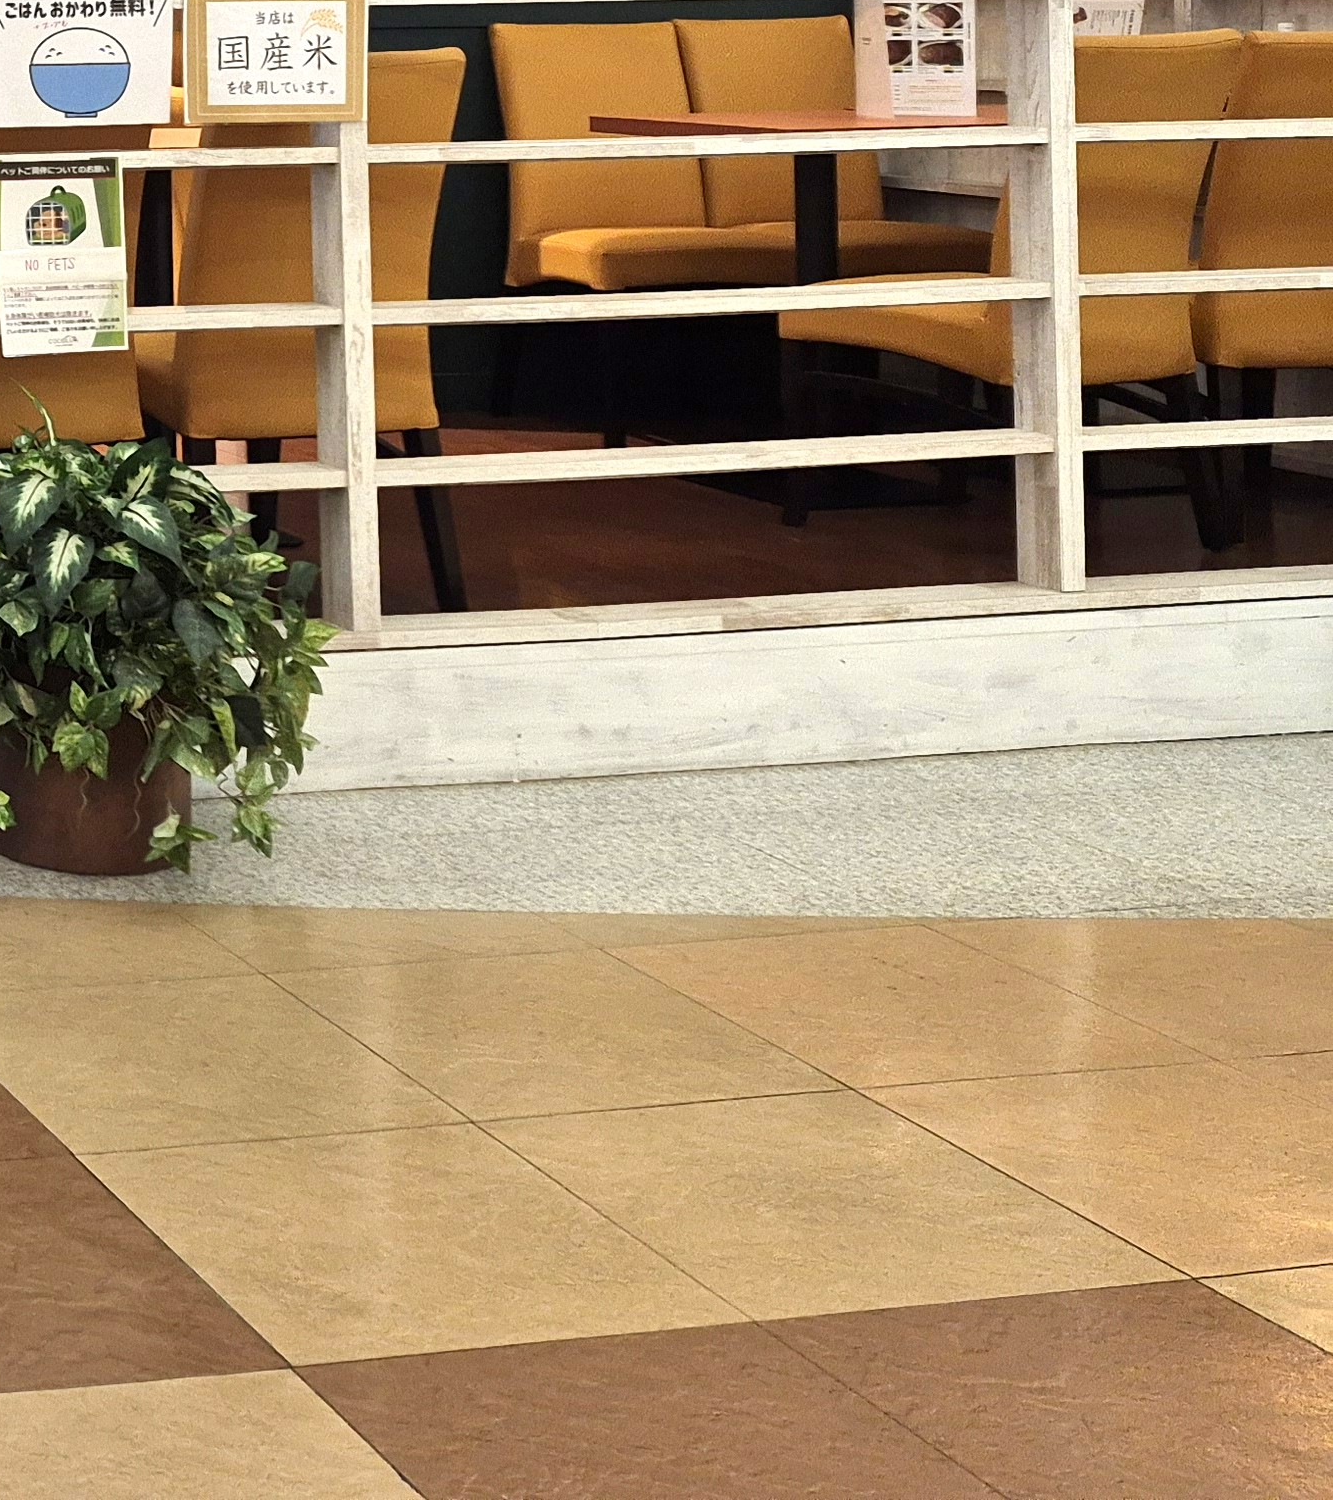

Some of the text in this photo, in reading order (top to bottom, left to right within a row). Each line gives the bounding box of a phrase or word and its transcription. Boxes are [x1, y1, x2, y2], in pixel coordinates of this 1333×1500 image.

[255, 10, 294, 26] 当店は
[217, 32, 338, 73] 国産米
[226, 80, 336, 96] を使用しています。
[25, 259, 40, 271] NO
